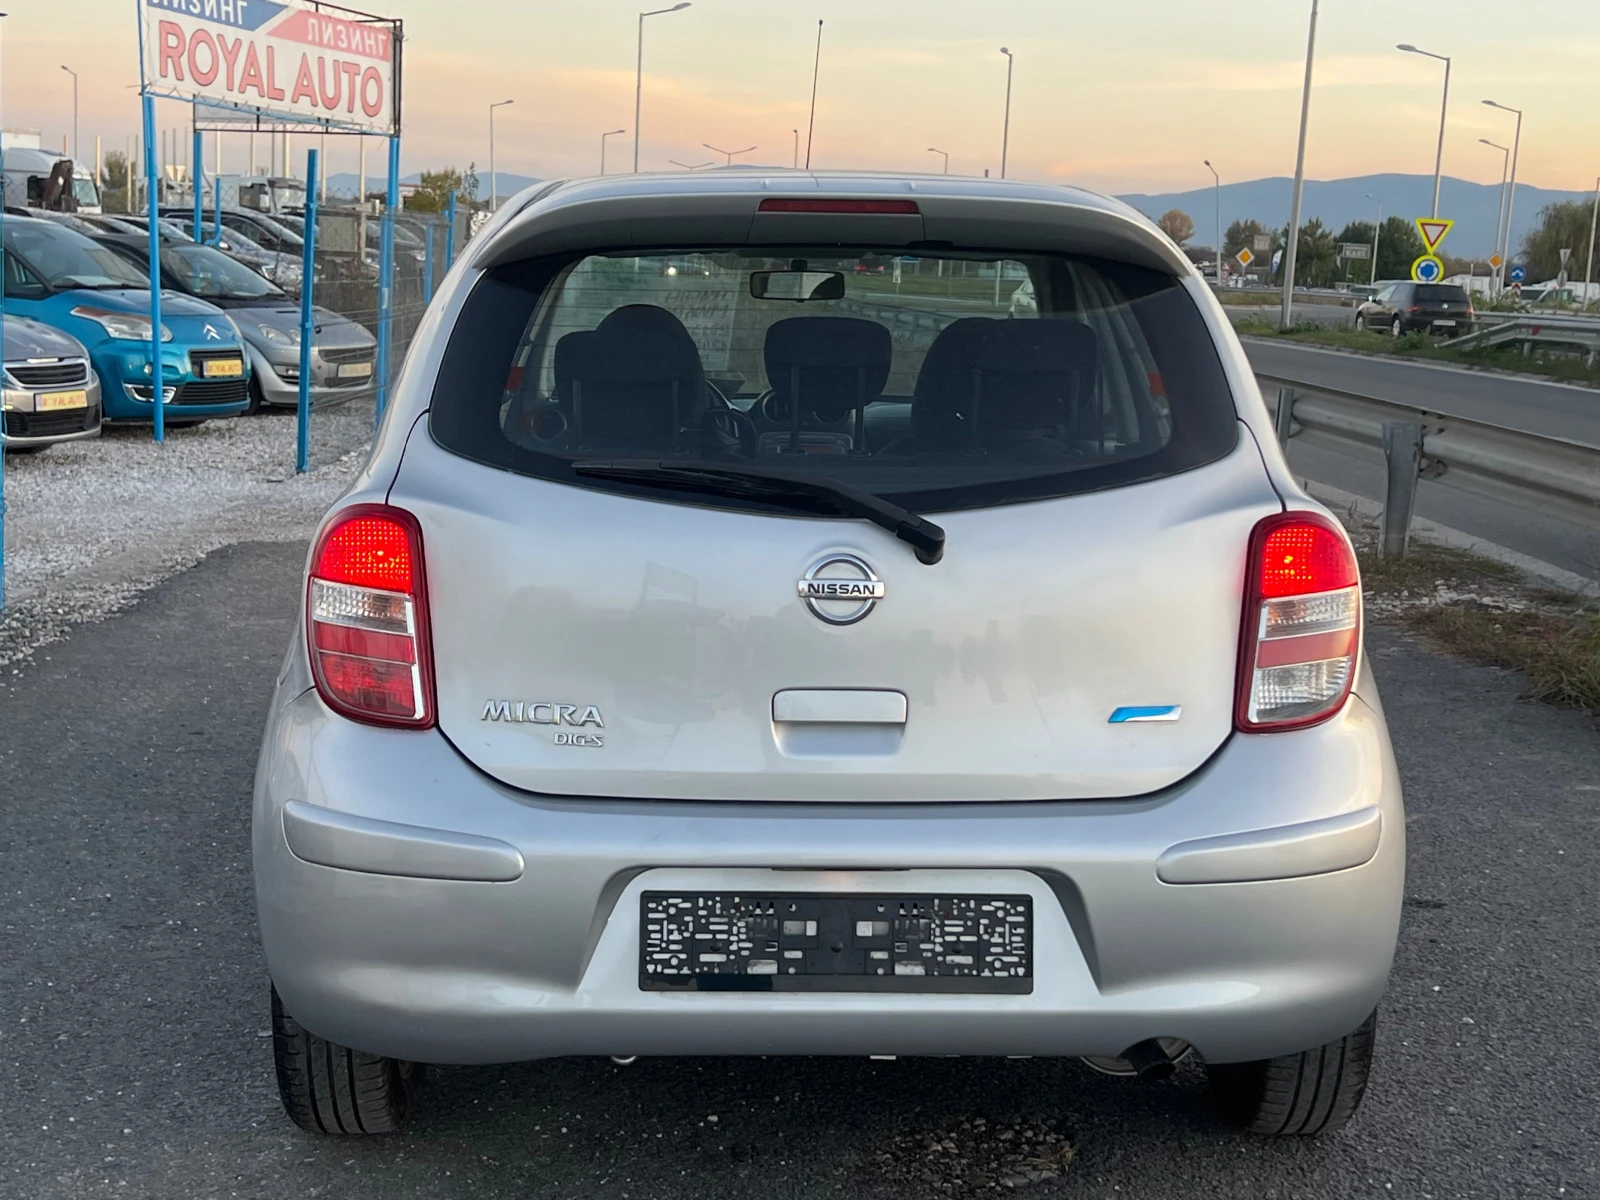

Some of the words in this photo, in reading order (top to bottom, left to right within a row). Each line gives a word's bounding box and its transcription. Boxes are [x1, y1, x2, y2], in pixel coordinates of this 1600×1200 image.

[152, 0, 248, 25] ЗИНГ
[307, 17, 387, 57] ЛИЗИНГ
[158, 19, 286, 102] ROYAL
[290, 51, 384, 118] AUTO
[42, 395, 68, 407] RYAL
[807, 582, 875, 595] NISSAN
[481, 698, 605, 728] MICRA
[553, 731, 605, 748] DIG-S
